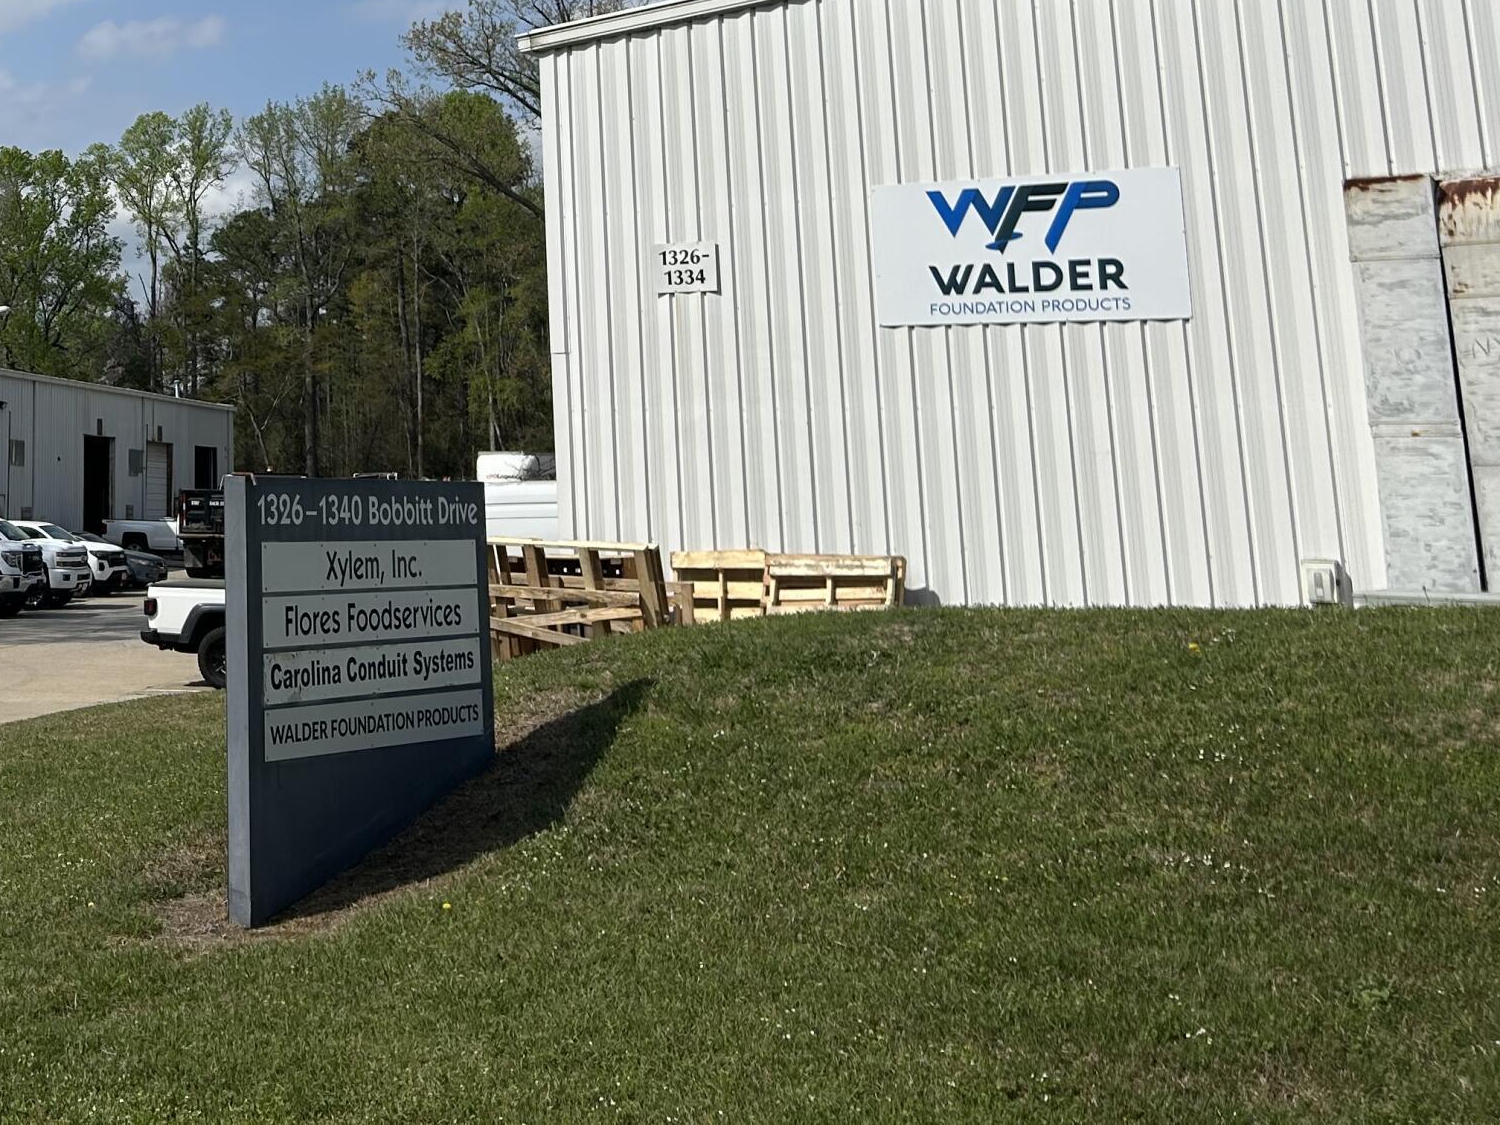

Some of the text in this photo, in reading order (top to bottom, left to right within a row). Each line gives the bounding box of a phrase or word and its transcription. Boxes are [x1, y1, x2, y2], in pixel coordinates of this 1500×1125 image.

[925, 179, 1120, 255] WFP
[658, 248, 710, 266] 1326-
[663, 268, 706, 286] 1334
[928, 257, 1129, 296] WALDER
[930, 297, 1131, 316] FOUNDATION PRODUCTS
[368, 496, 434, 525] Bobbitt
[438, 496, 478, 525] Drive
[326, 550, 423, 587] Xylem, Inc.
[285, 598, 462, 637] Flores Foodservices
[270, 649, 475, 690] Carolina Conduit Systems
[270, 703, 479, 746] WALDER FOUNDATION PRODUCTS
